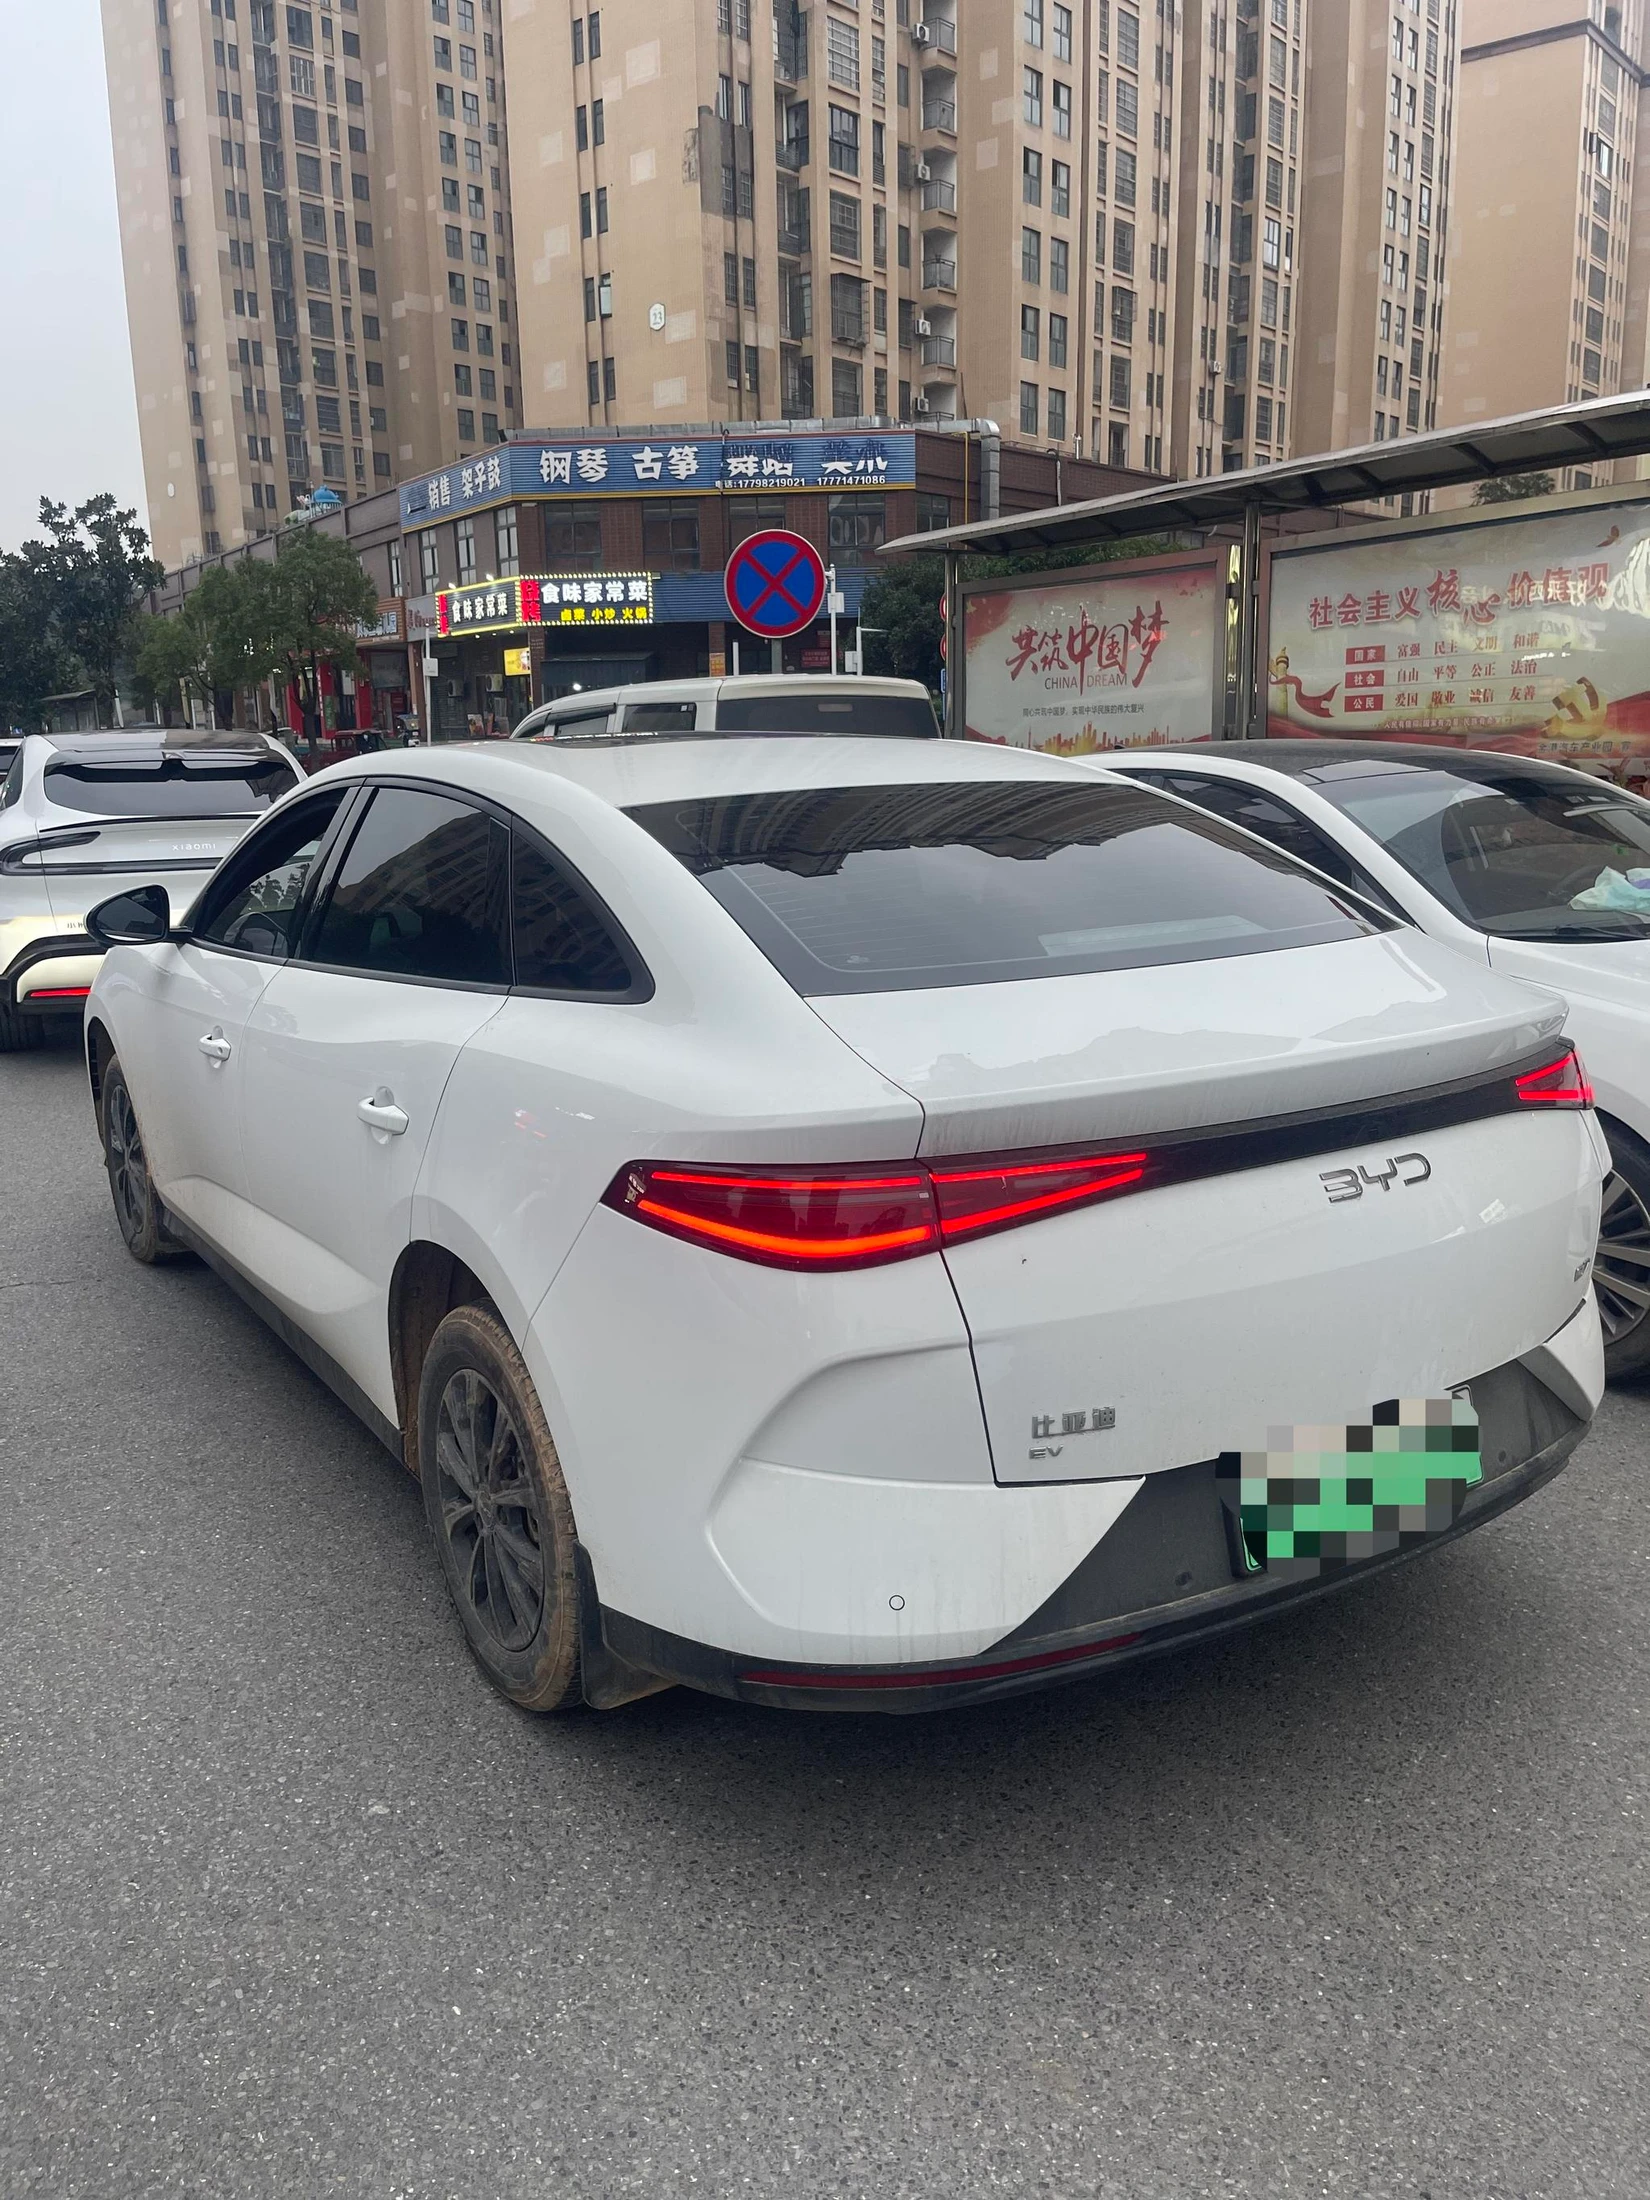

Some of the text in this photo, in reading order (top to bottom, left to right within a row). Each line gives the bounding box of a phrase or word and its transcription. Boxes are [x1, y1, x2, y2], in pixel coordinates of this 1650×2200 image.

[540, 449, 608, 484] 钢琴
[632, 445, 699, 480] 古筝
[428, 475, 450, 511] 销售
[461, 456, 501, 499] 架子鼓
[817, 475, 886, 486] 17771471086
[541, 581, 648, 604] 食味家常菜
[452, 592, 508, 623] 食味家常菜
[592, 607, 616, 620] 小炒
[622, 606, 647, 620] 火锅
[1005, 601, 1169, 695] 共筑中国梦
[1354, 632, 1540, 662] 国家 富强 民主 文明 和谐
[1044, 673, 1127, 690] CHINA DREAM
[1354, 660, 1538, 686] 社会 自由 平等 公正 法治
[1353, 697, 1375, 710] 公民
[1395, 692, 1418, 707] 爱国
[1431, 690, 1456, 707] 敬业
[1509, 685, 1536, 700] 友善
[172, 843, 216, 851] xiaomi
[1319, 1153, 1431, 1203] BYD
[1031, 1405, 1115, 1439] 比亚迪
[1028, 1444, 1064, 1459] EV
